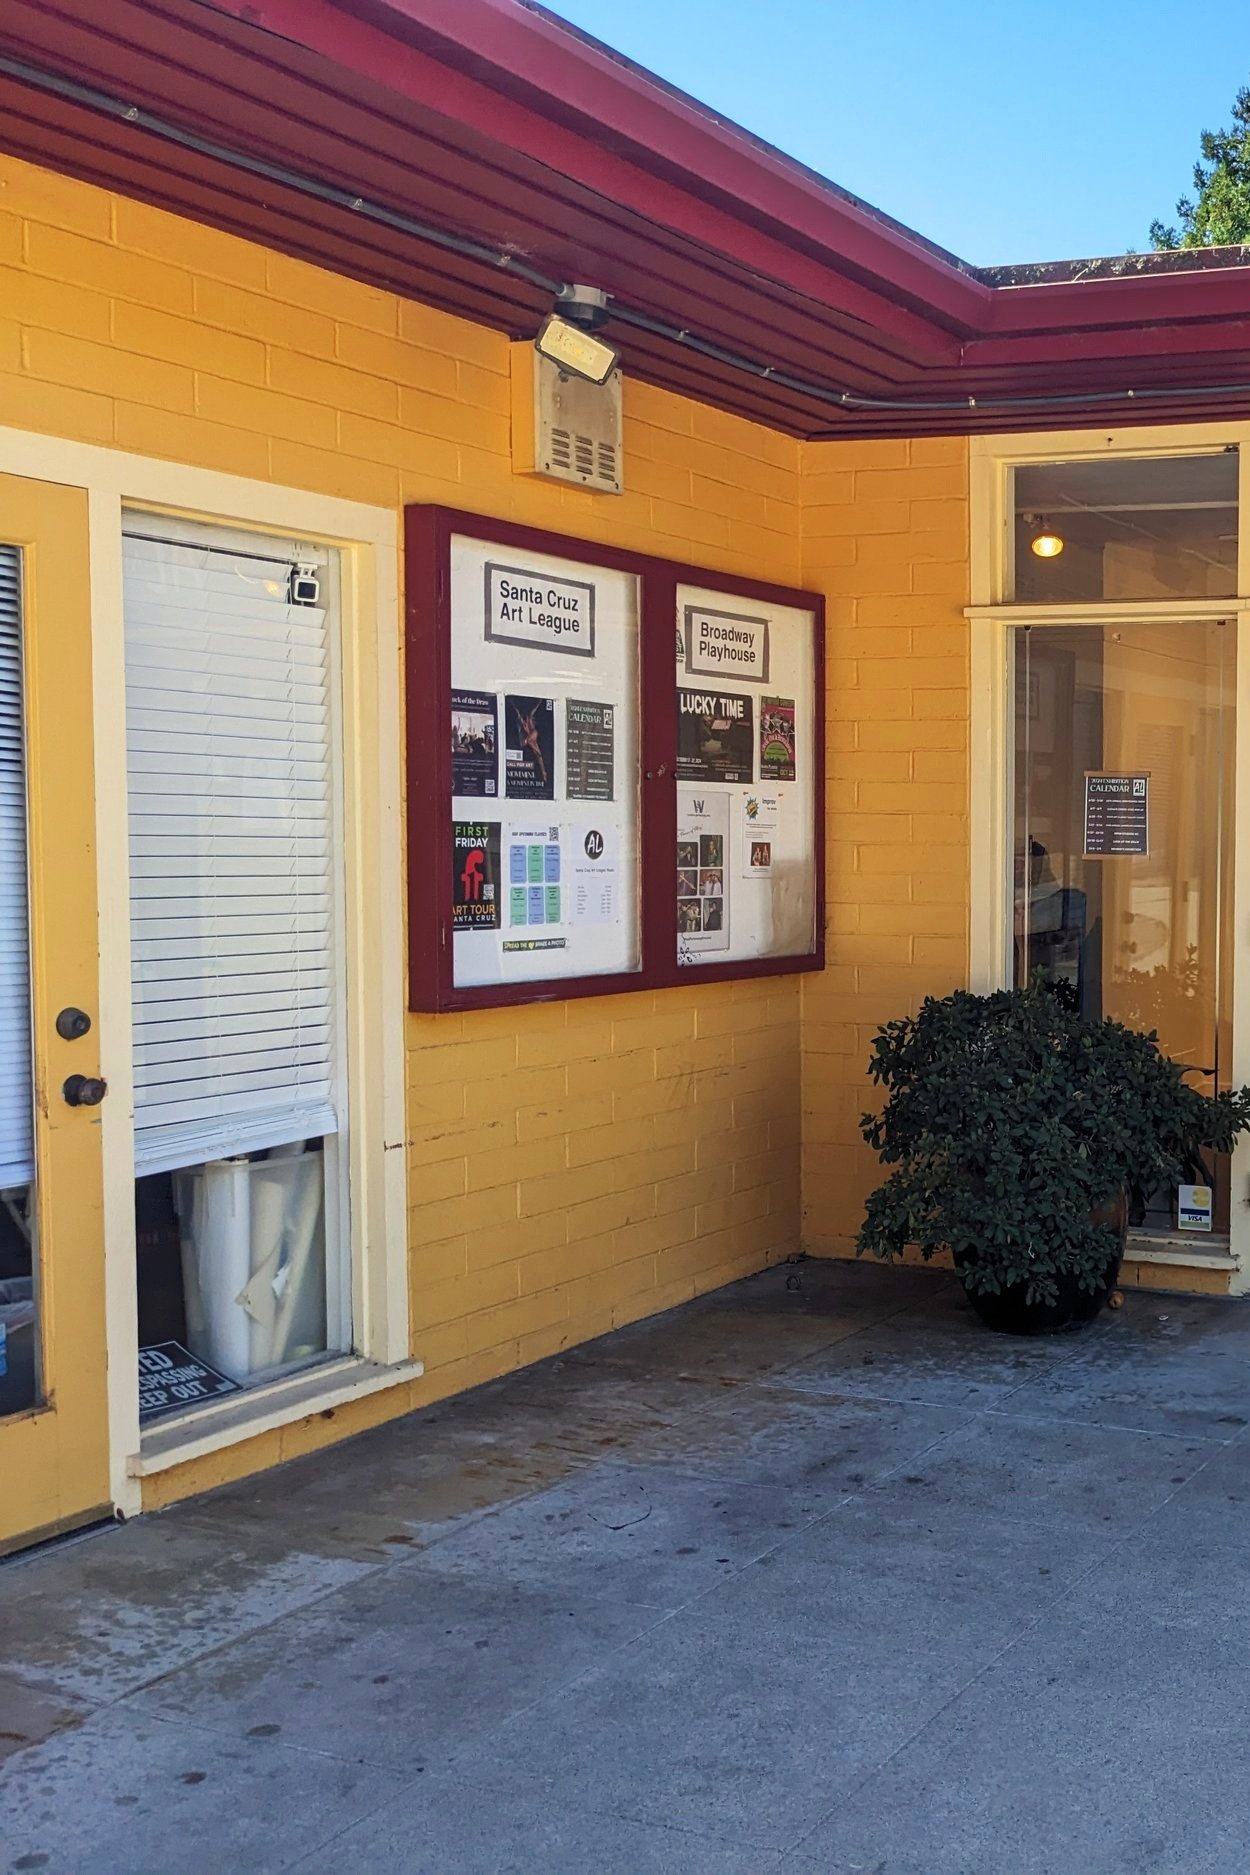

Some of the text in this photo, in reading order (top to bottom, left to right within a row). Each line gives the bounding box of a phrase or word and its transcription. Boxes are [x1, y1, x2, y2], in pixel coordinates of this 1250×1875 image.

[500, 580, 579, 612] Santa Cruz
[500, 602, 580, 634] Art League
[701, 622, 755, 648] Broadway
[699, 641, 756, 663] Playhouse
[680, 693, 744, 719] LUCKY TIME
[569, 713, 602, 723] CALENDAR
[1090, 785, 1130, 793] CALENDAR
[455, 827, 489, 836] FIRST
[455, 838, 489, 848] FRIDAY
[470, 904, 495, 914] TOUR
[171, 1381, 208, 1399] OUT
